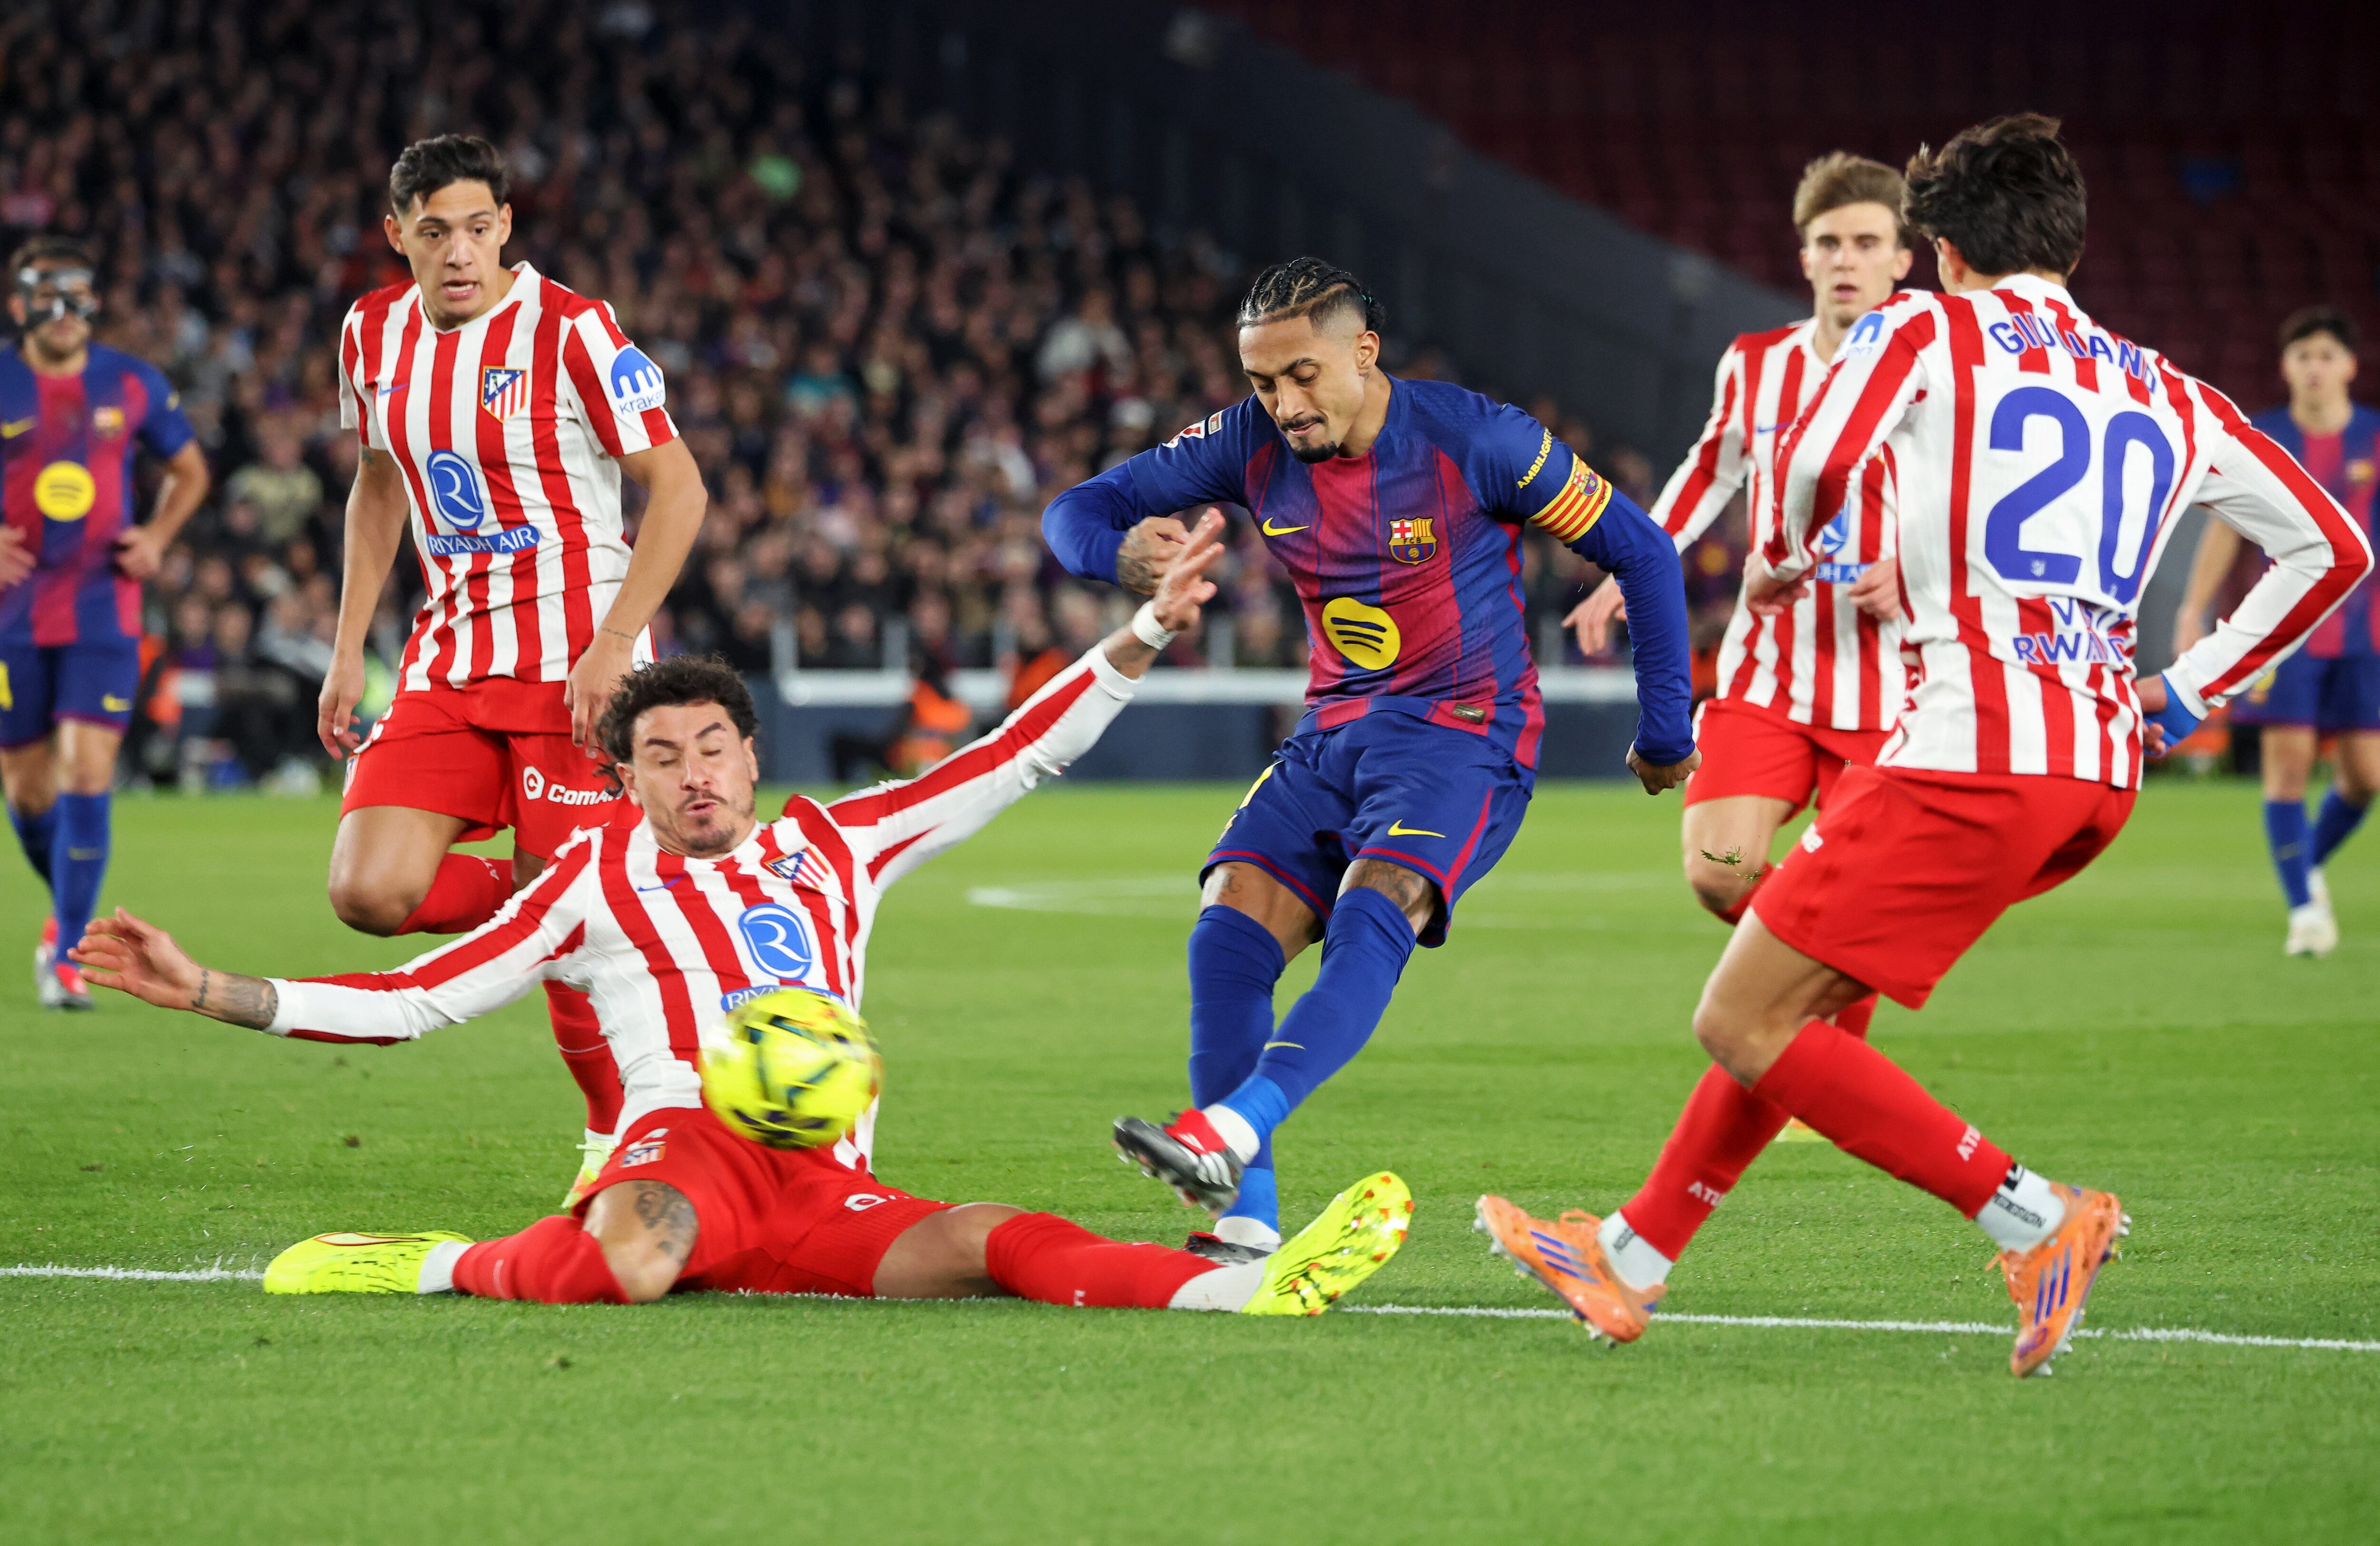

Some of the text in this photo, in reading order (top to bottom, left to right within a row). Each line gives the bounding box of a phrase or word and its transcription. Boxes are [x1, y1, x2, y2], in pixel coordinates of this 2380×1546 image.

[1988, 311, 2155, 395] GIULIANO
[1985, 386, 2174, 605] 20
[428, 527, 536, 554] RIYADH AIR
